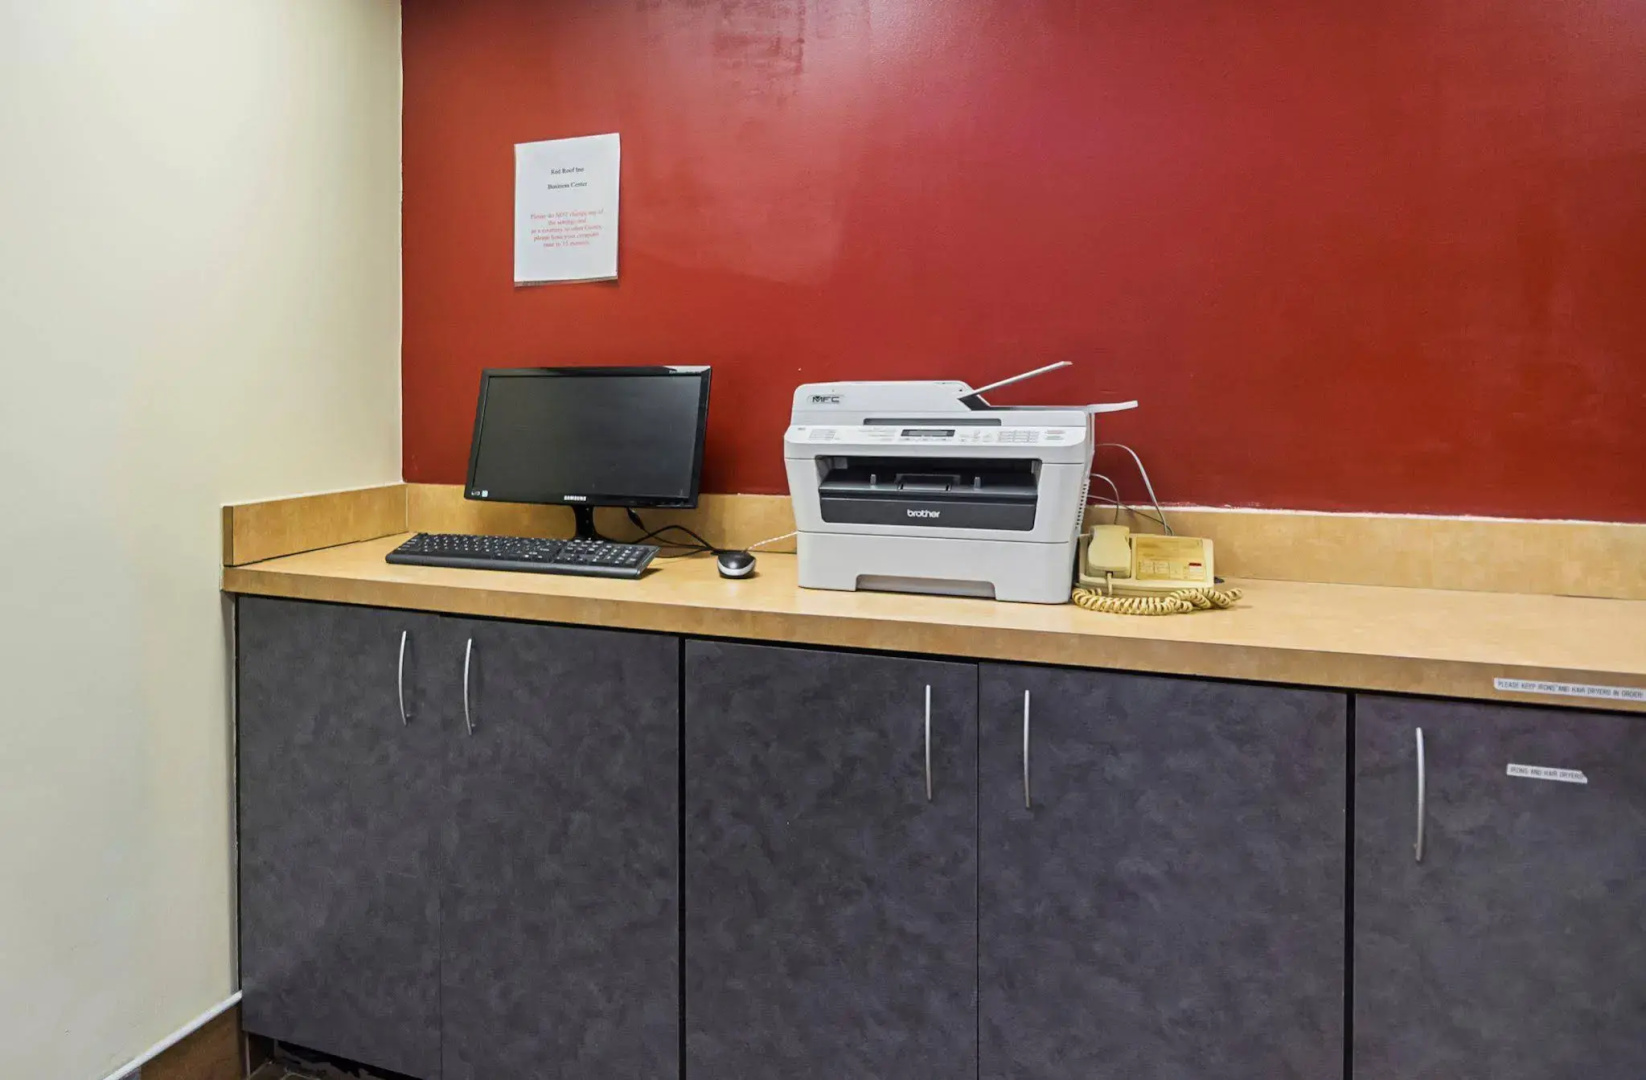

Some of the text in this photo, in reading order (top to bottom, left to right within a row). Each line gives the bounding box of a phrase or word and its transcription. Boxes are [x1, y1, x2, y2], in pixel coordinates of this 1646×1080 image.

[562, 166, 575, 174] Roof
[907, 509, 940, 518] brother
[1498, 680, 1519, 689] PLEASE
[1587, 687, 1612, 696] DRYERS
